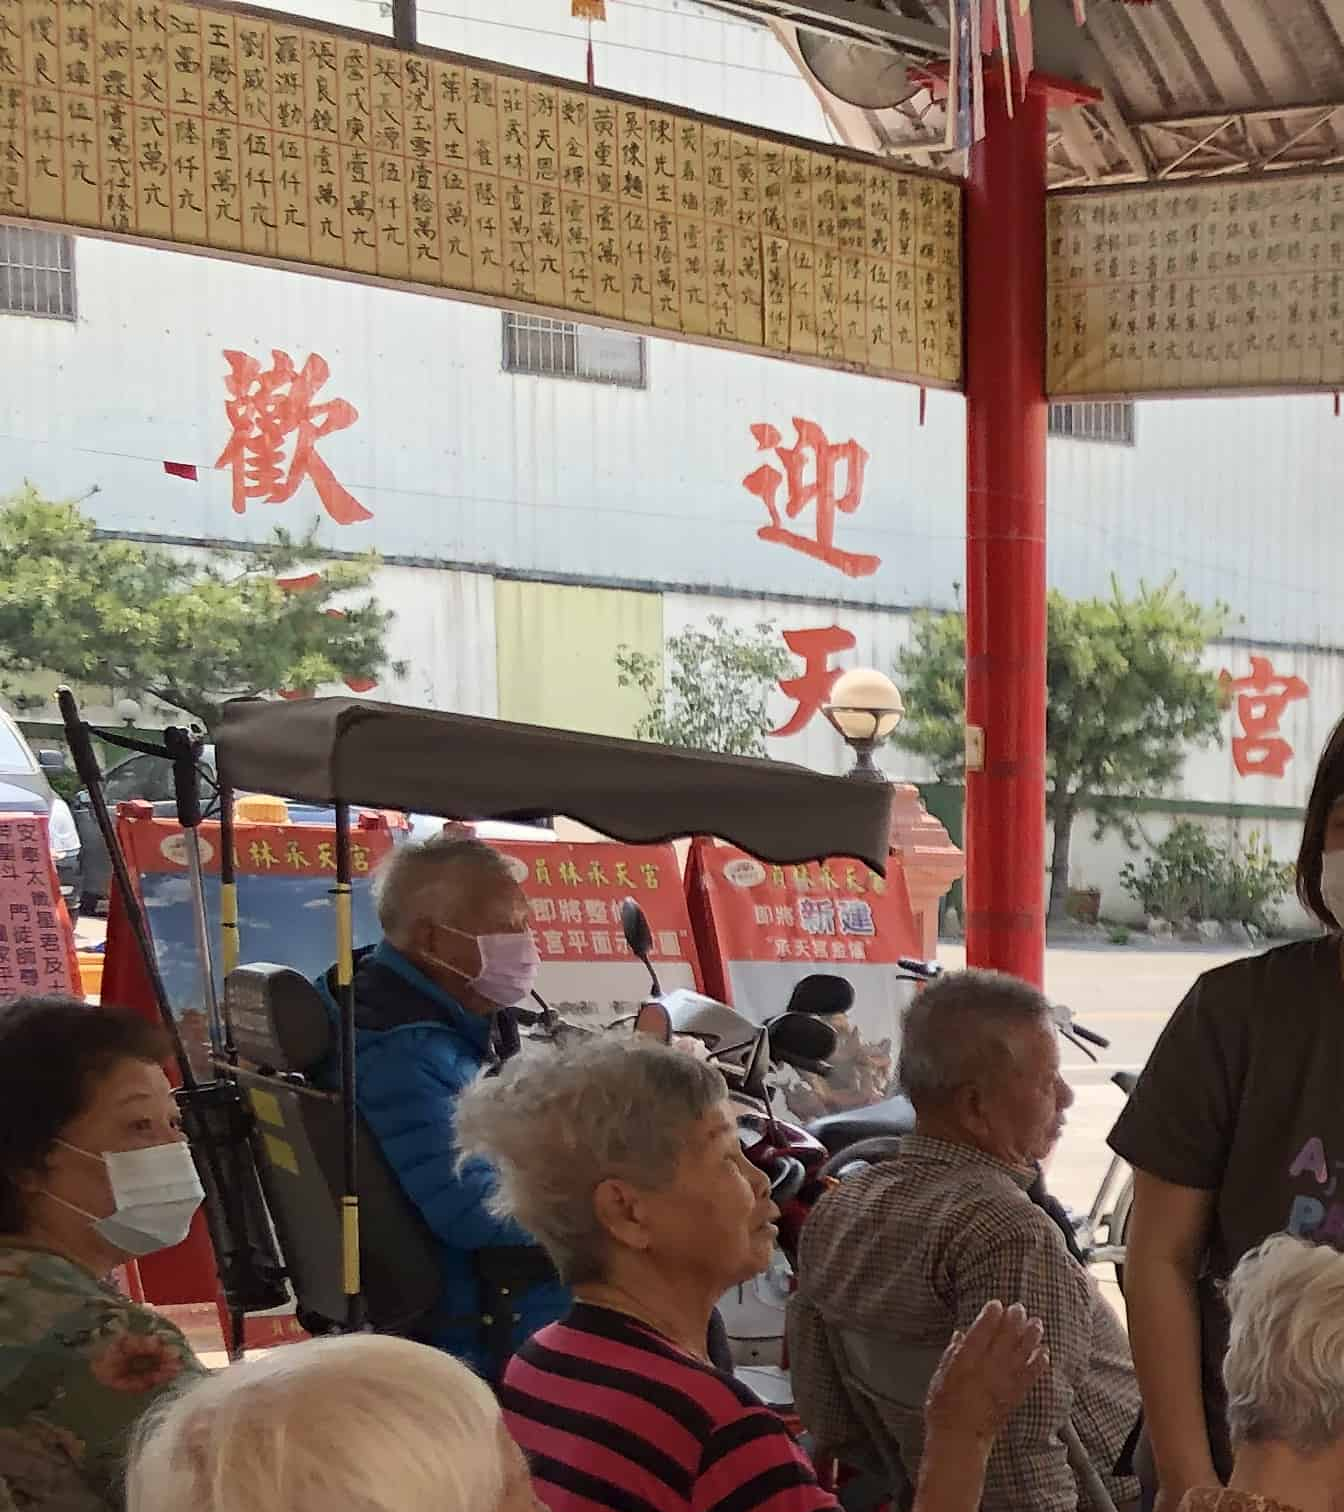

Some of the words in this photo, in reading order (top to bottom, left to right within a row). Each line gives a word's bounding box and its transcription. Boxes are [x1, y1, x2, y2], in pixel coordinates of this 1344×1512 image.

[1219, 656, 1309, 779] 宮
[535, 858, 660, 889] 員林承天宮
